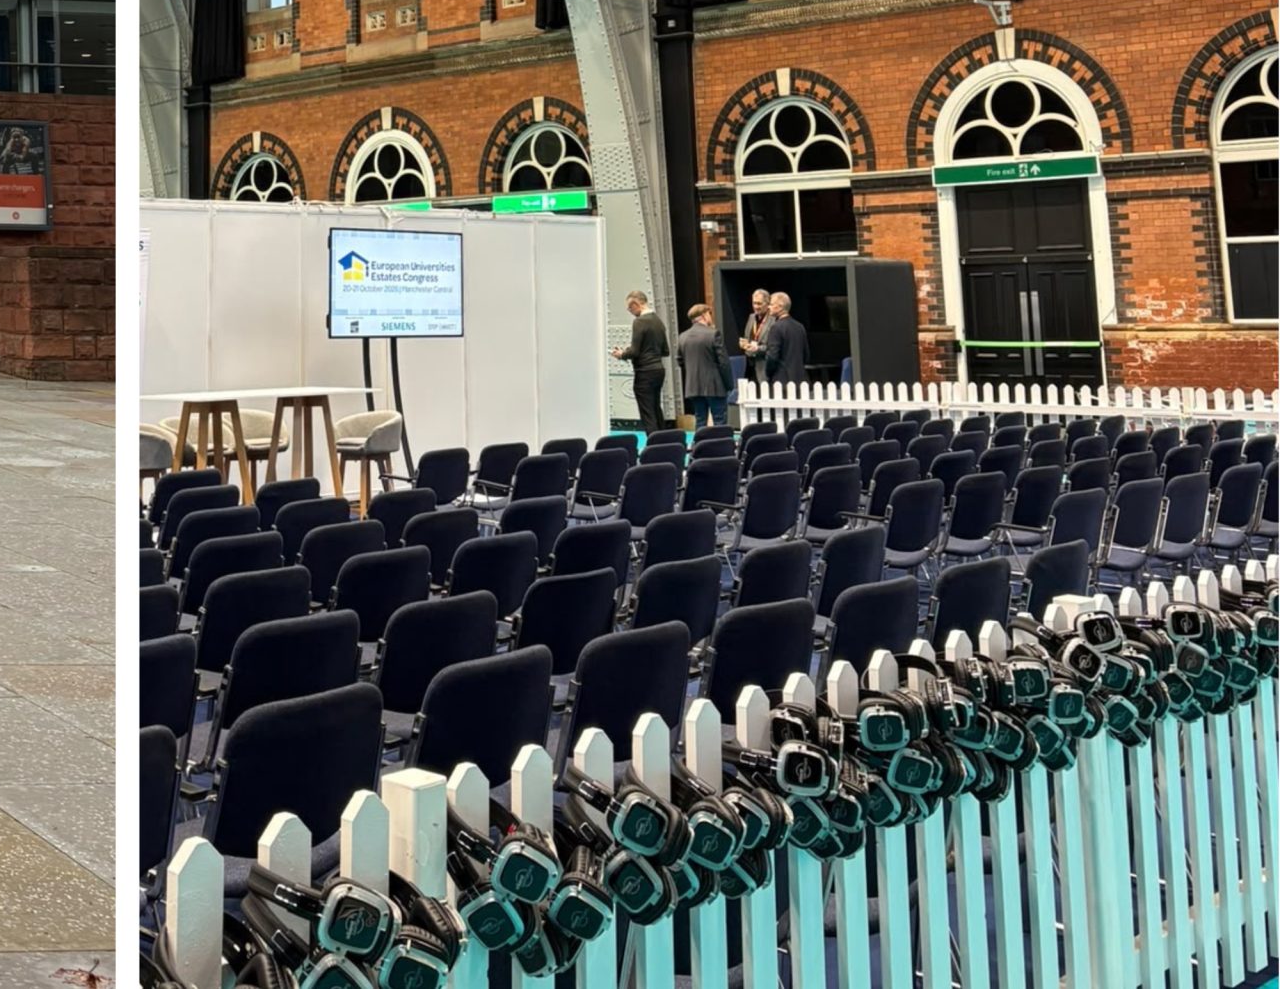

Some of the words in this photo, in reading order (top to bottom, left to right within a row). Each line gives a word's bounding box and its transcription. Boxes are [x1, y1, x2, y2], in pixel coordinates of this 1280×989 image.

[986, 168, 1001, 177] Fire
[371, 260, 410, 272] European
[411, 261, 456, 272] Universities
[371, 272, 402, 282] Estates
[402, 272, 439, 284] Congress
[381, 321, 416, 331] SIEMENS
